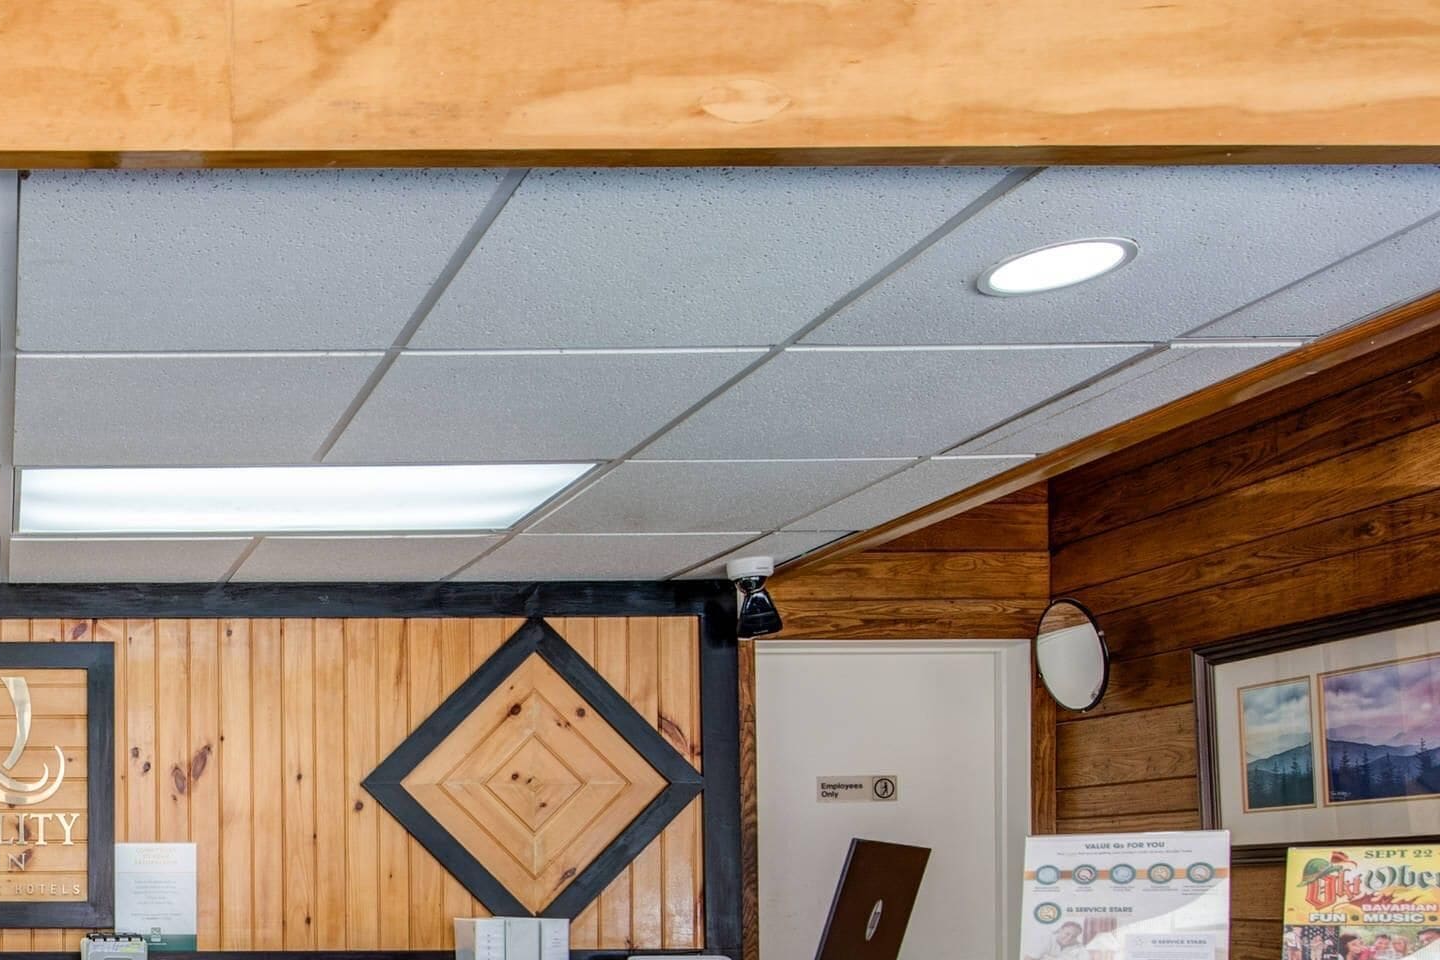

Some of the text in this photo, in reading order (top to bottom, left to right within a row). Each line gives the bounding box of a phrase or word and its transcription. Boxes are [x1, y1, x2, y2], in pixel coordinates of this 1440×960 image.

[1364, 849, 1433, 859] SEPT 22
[15, 884, 81, 895] HOTELS
[1362, 903, 1437, 912] BAVARIAN
[1309, 912, 1425, 923] FUN MUSIC
